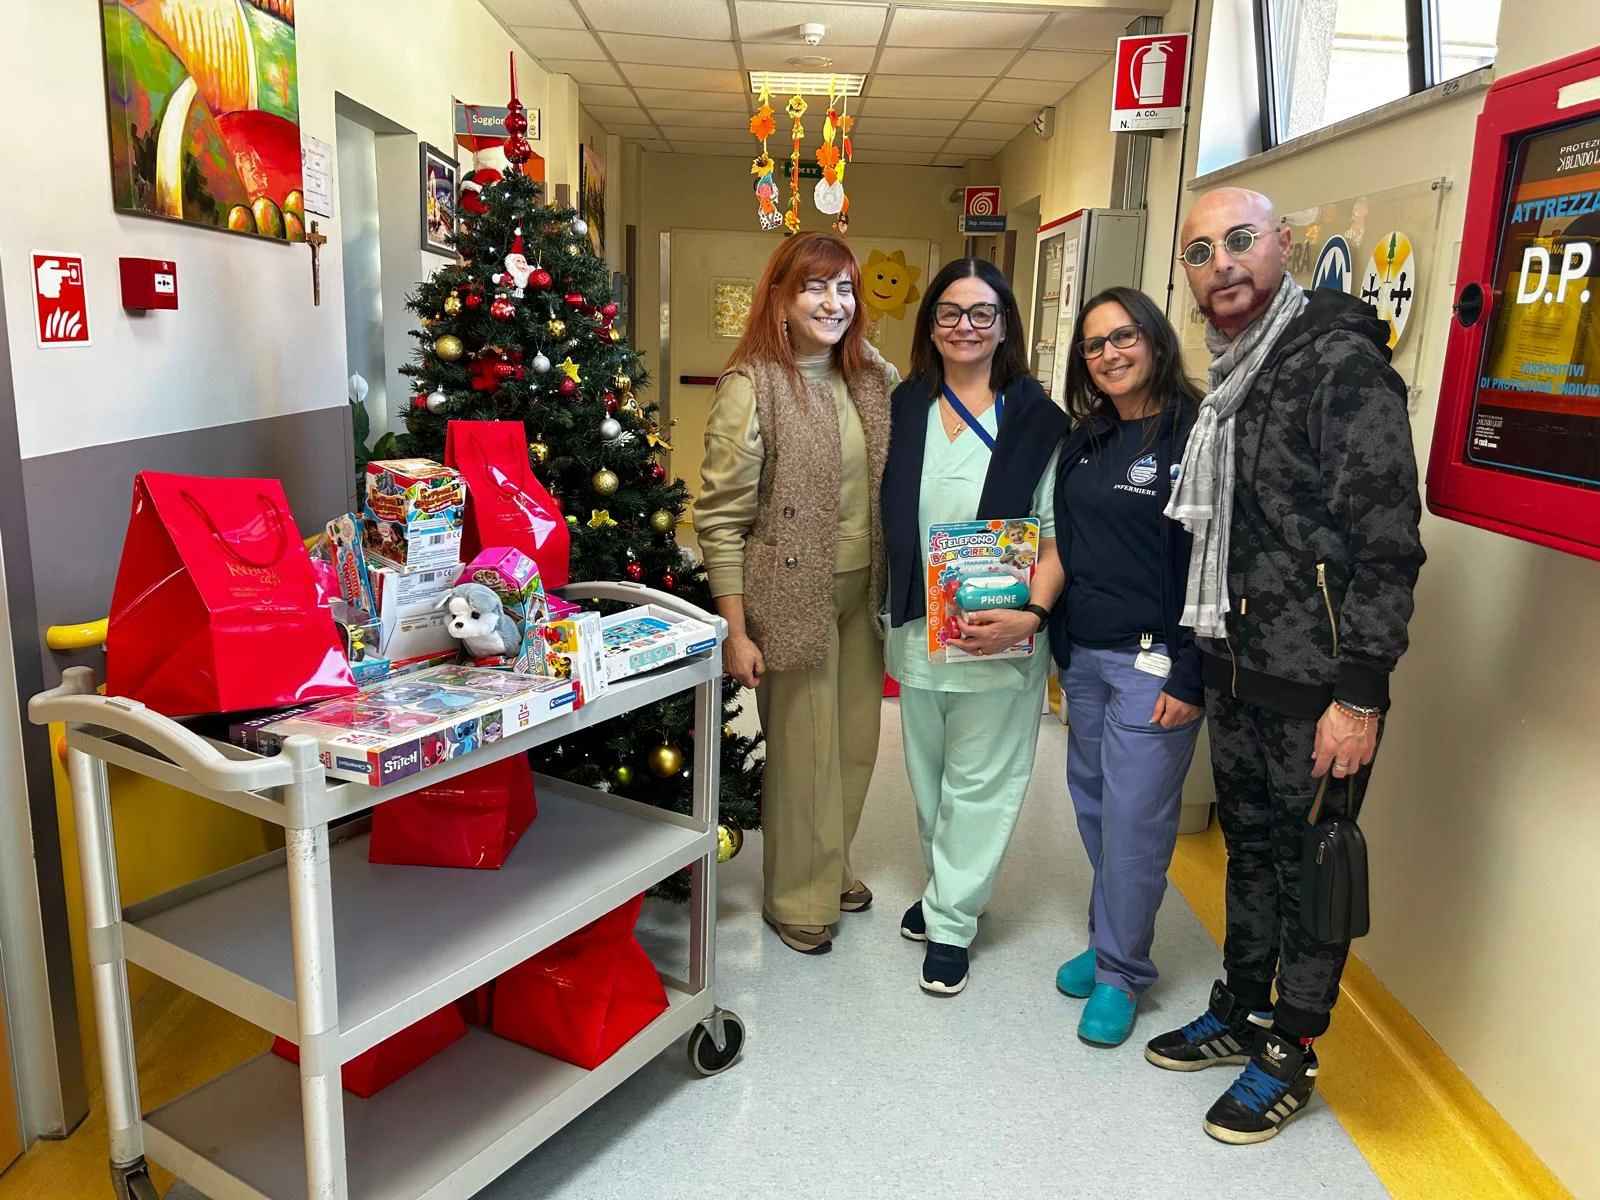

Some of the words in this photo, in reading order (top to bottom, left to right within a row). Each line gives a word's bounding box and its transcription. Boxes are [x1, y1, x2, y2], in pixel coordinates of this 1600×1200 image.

[472, 114, 505, 126] Soggior
[1120, 120, 1130, 129] N.
[1480, 376, 1490, 389] DI
[1113, 484, 1157, 497] INFERMIERE
[939, 534, 996, 550] TELEFONO
[930, 550, 959, 565] BABY
[959, 546, 1004, 559] GIRELLO
[980, 594, 1017, 605] PHONE
[519, 702, 529, 713] 24
